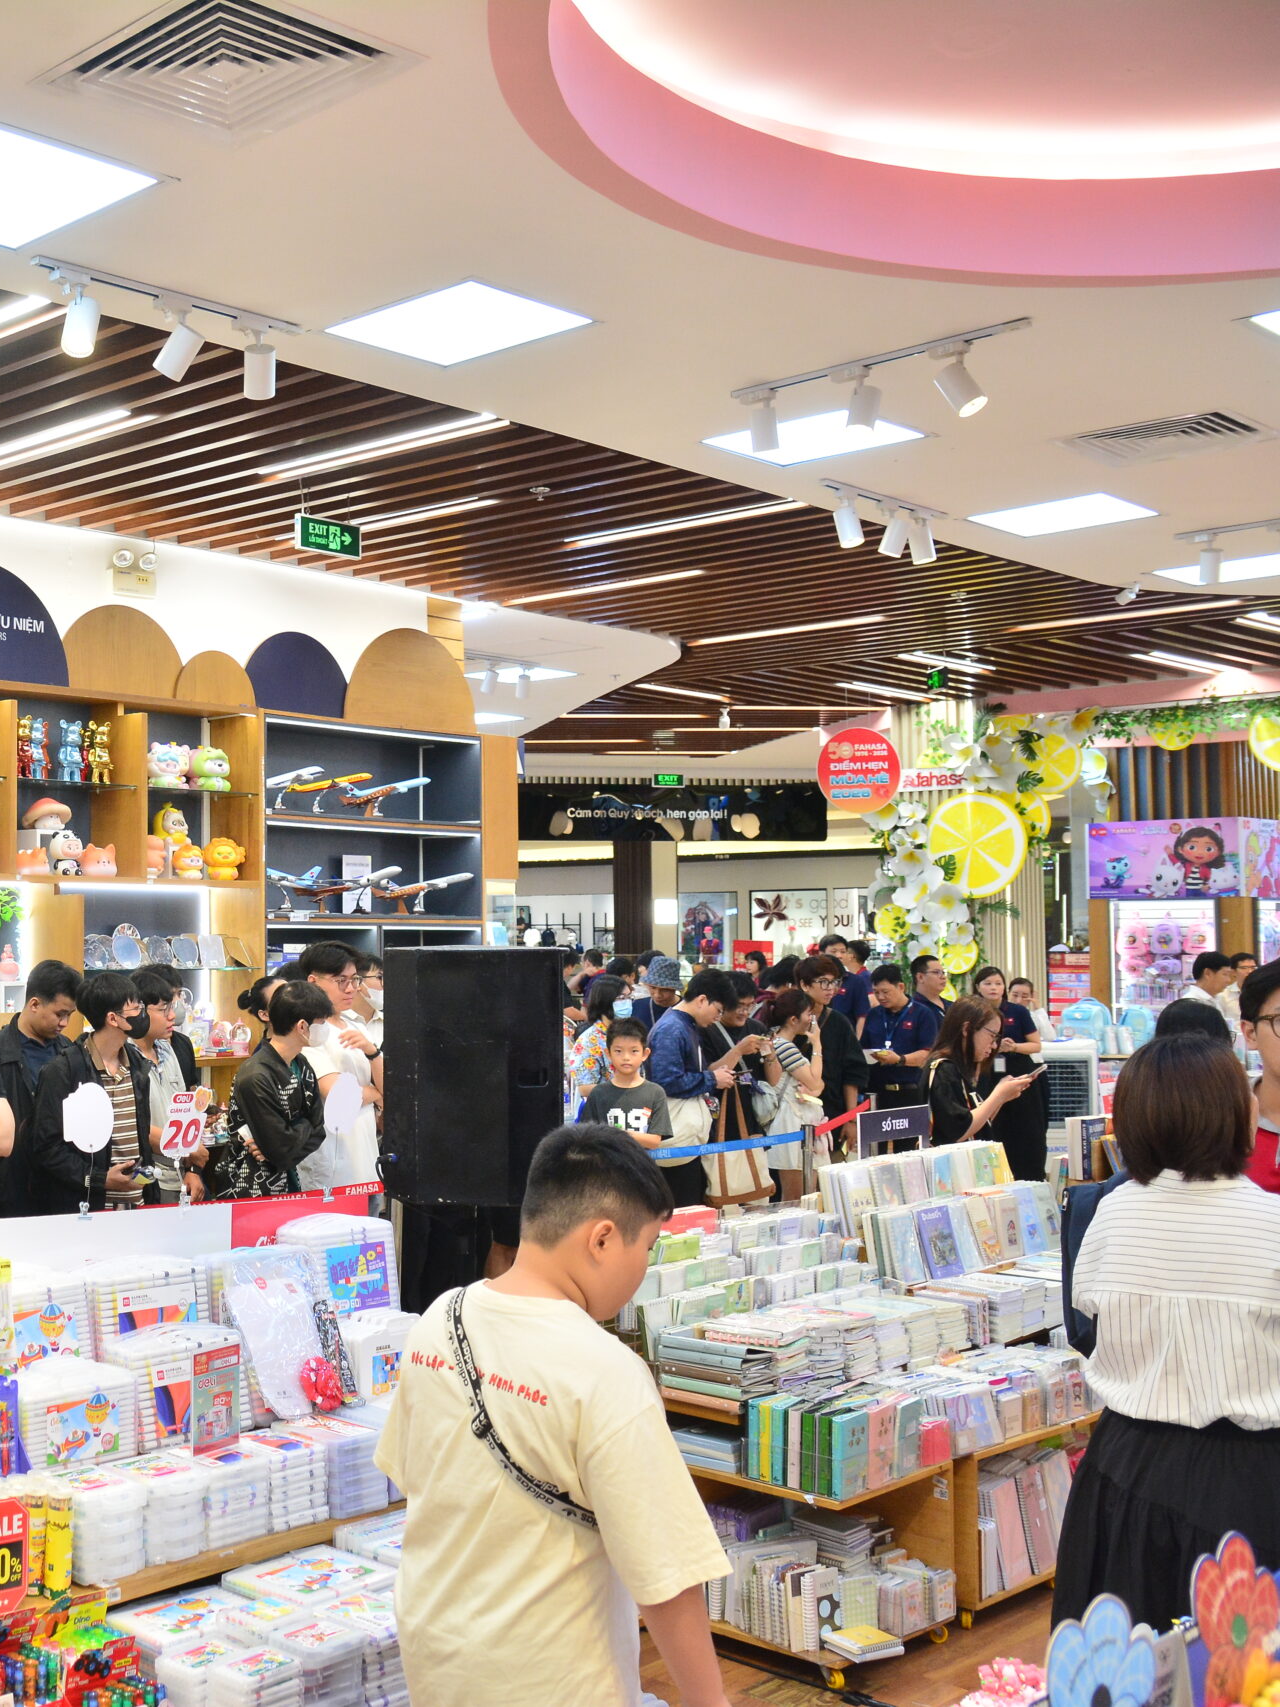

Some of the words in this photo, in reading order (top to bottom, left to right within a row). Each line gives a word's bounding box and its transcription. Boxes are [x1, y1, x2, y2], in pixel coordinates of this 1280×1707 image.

[308, 522, 328, 536] EXIT
[13, 616, 45, 634] NIỆM
[830, 760, 862, 771] ĐIỂM
[863, 761, 889, 771] HẸN
[830, 772, 867, 785] MÙA
[869, 771, 889, 784] HÈ
[916, 771, 965, 787] fahas
[799, 918, 813, 928] SEE
[892, 1118, 909, 1130] TEEN
[163, 1118, 201, 1150] 20
[345, 1184, 379, 1196] FAHASA
[221, 1358, 232, 1366] deli
[453, 1347, 469, 1387] adidas
[461, 1339, 477, 1381] adidas
[198, 1375, 216, 1390] deli
[516, 1474, 554, 1505] adidas
[10, 1573, 22, 1582] OFF
[74, 1615, 91, 1625] Dino
